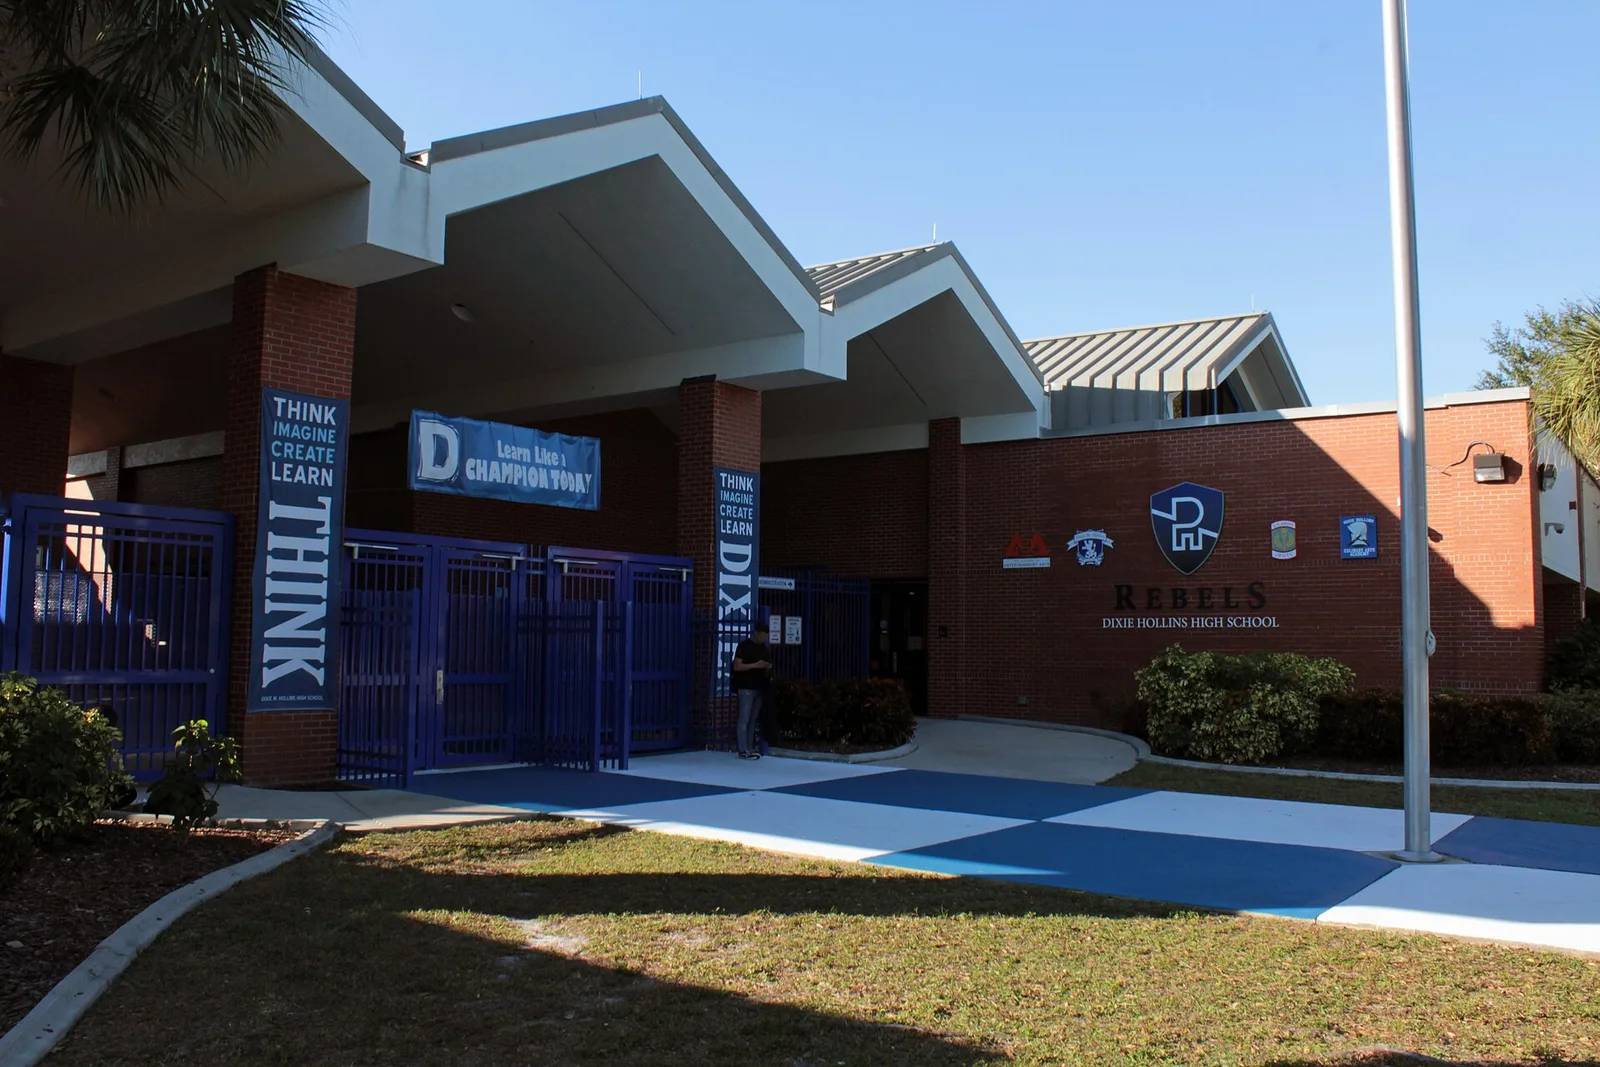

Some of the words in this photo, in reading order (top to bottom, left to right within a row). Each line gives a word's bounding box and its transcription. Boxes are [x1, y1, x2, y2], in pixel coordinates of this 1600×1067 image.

[273, 396, 336, 426] THINK
[273, 420, 336, 444] IMAGINE
[271, 440, 336, 464] CREATE
[417, 418, 459, 484] D
[497, 439, 531, 463] Learn
[534, 446, 558, 467] Like
[271, 461, 333, 487] LEARN
[465, 457, 548, 489] CHAMPION
[551, 469, 592, 494] TODAY
[720, 472, 754, 492] THINK
[720, 489, 754, 506] IMAGINE
[720, 503, 753, 520] CREATE
[720, 519, 753, 536] LEARN
[262, 496, 332, 689] THINK
[1113, 581, 1267, 610] REBELS
[1102, 617, 1134, 629] DIXIE
[1137, 617, 1188, 628] HOLLINS
[1191, 616, 1224, 628] HIGH
[1227, 616, 1280, 628] SCHOOL
